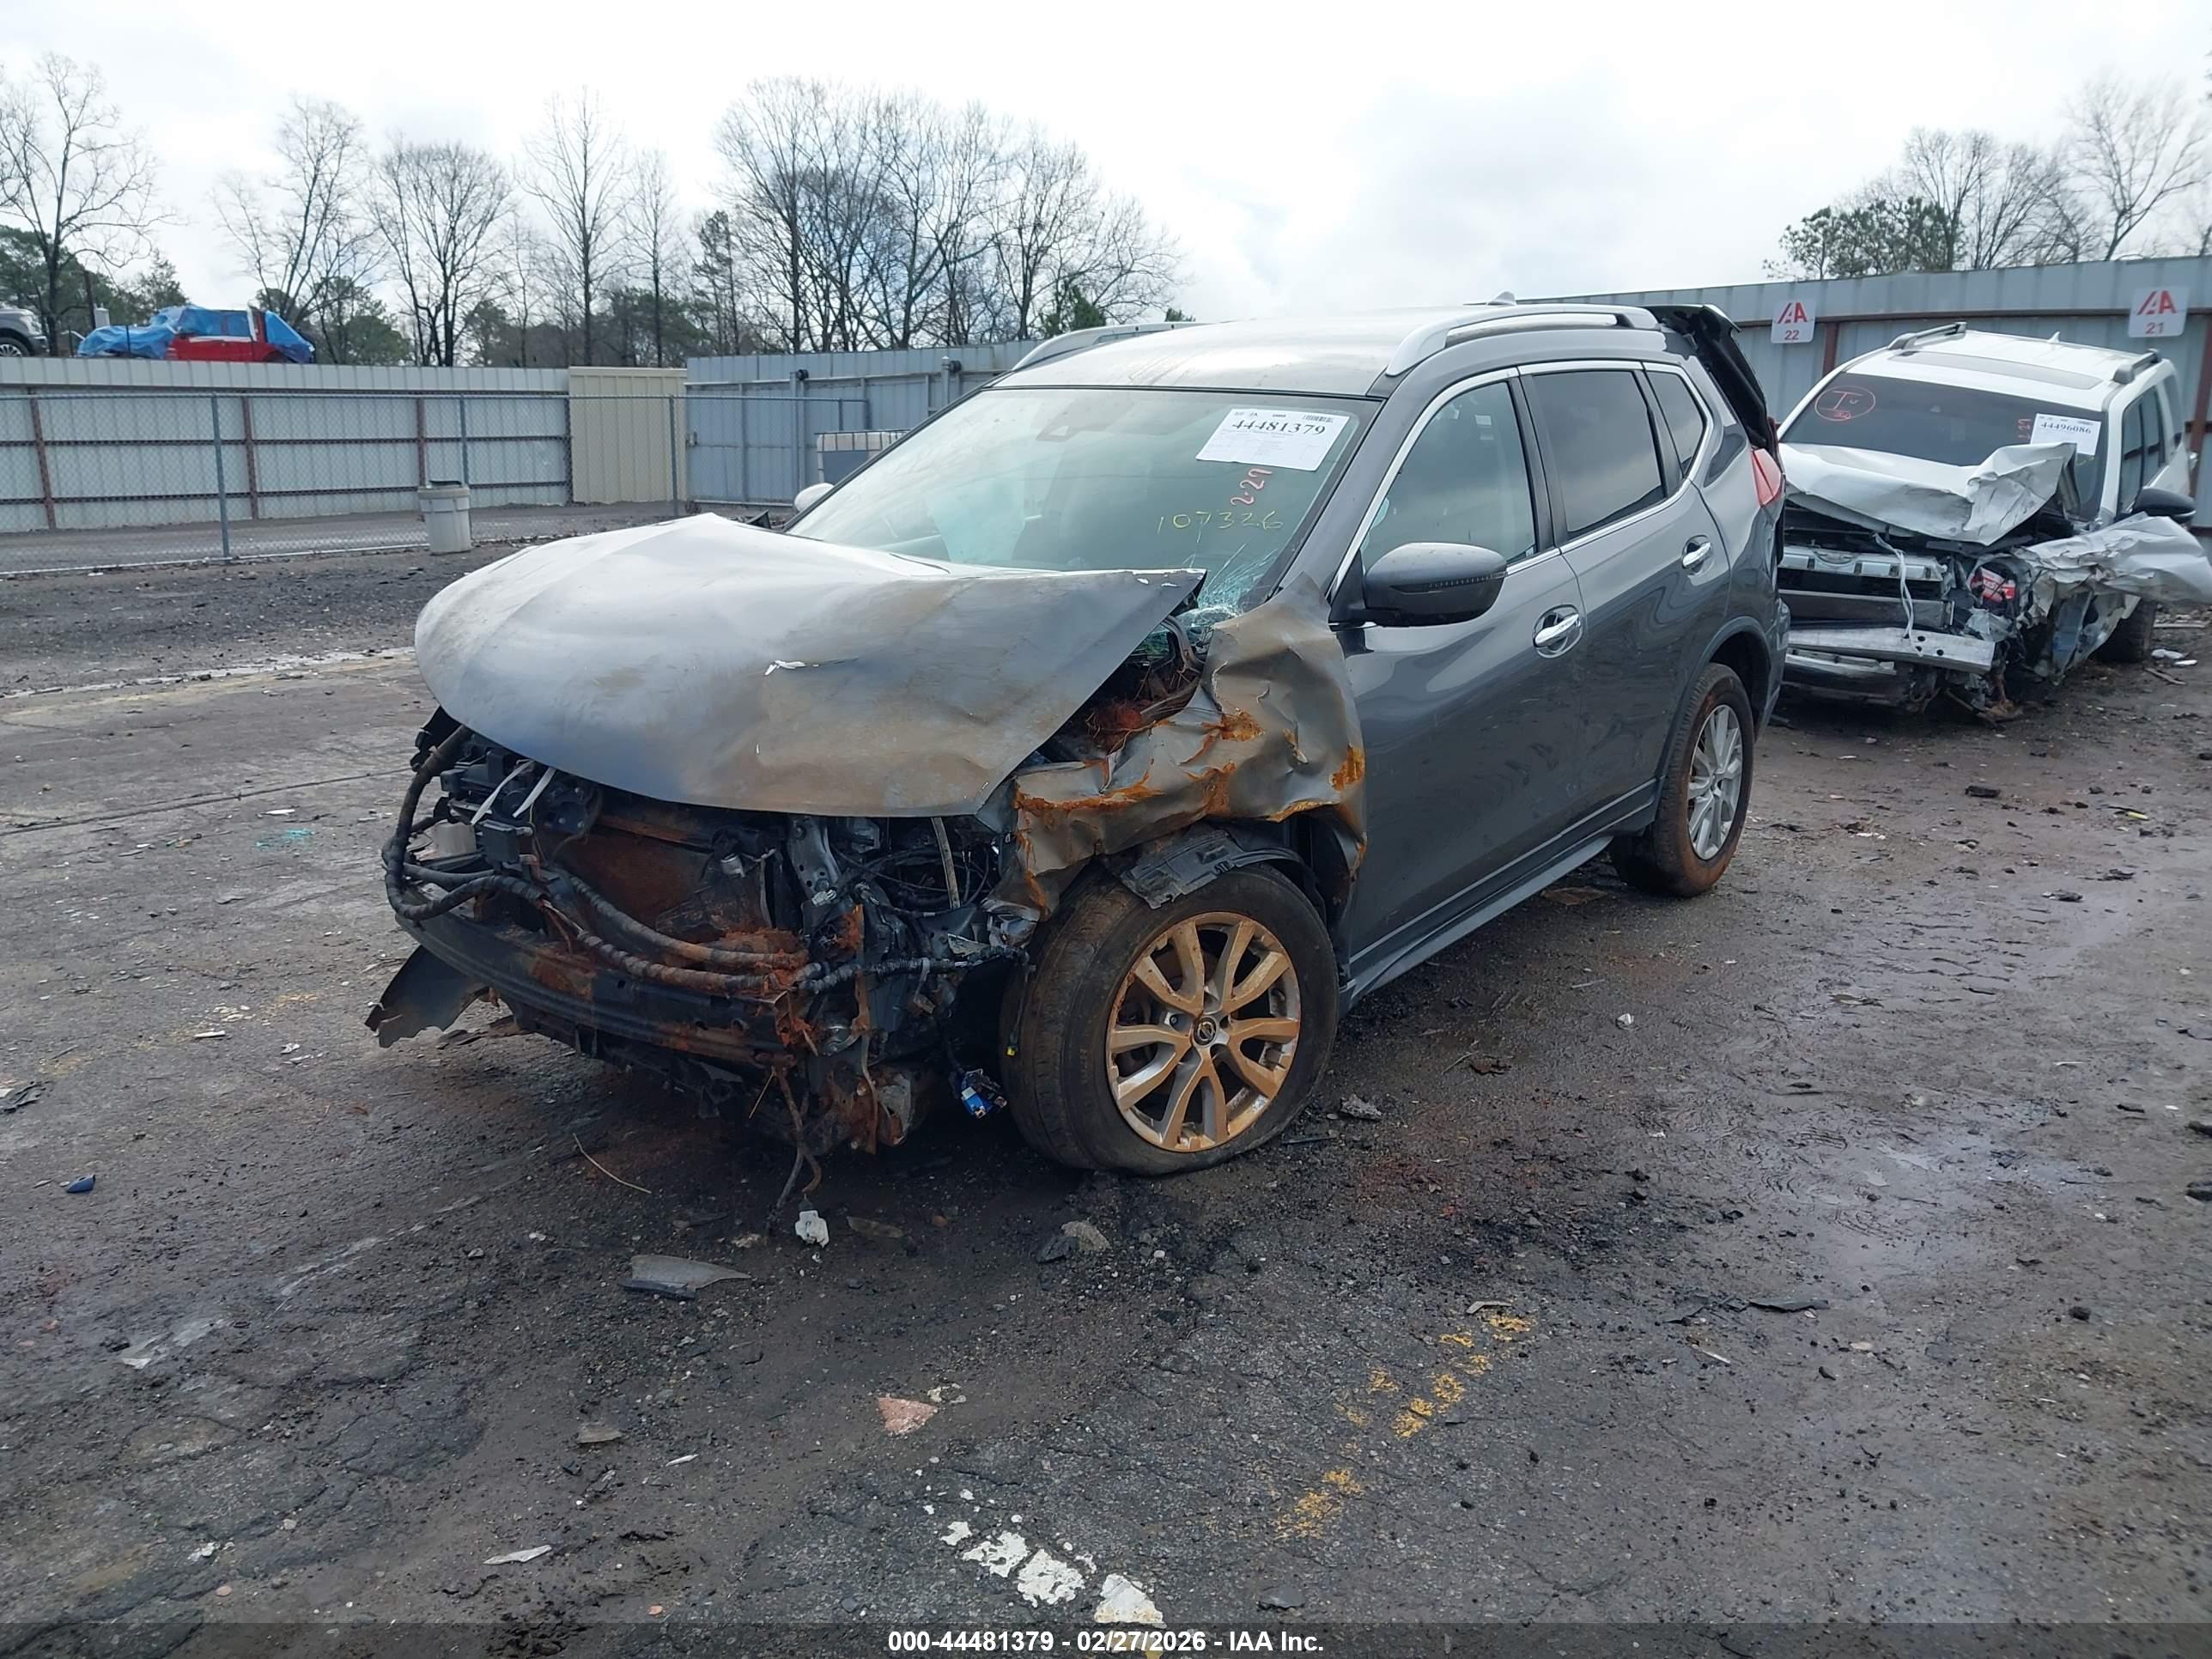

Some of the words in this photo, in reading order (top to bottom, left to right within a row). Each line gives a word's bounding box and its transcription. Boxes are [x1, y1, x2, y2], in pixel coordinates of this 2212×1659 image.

[2146, 322, 2164, 334] 21
[1784, 330, 1800, 340] 22
[1232, 419, 1326, 435] 44481379
[2040, 422, 2092, 434] 44496086
